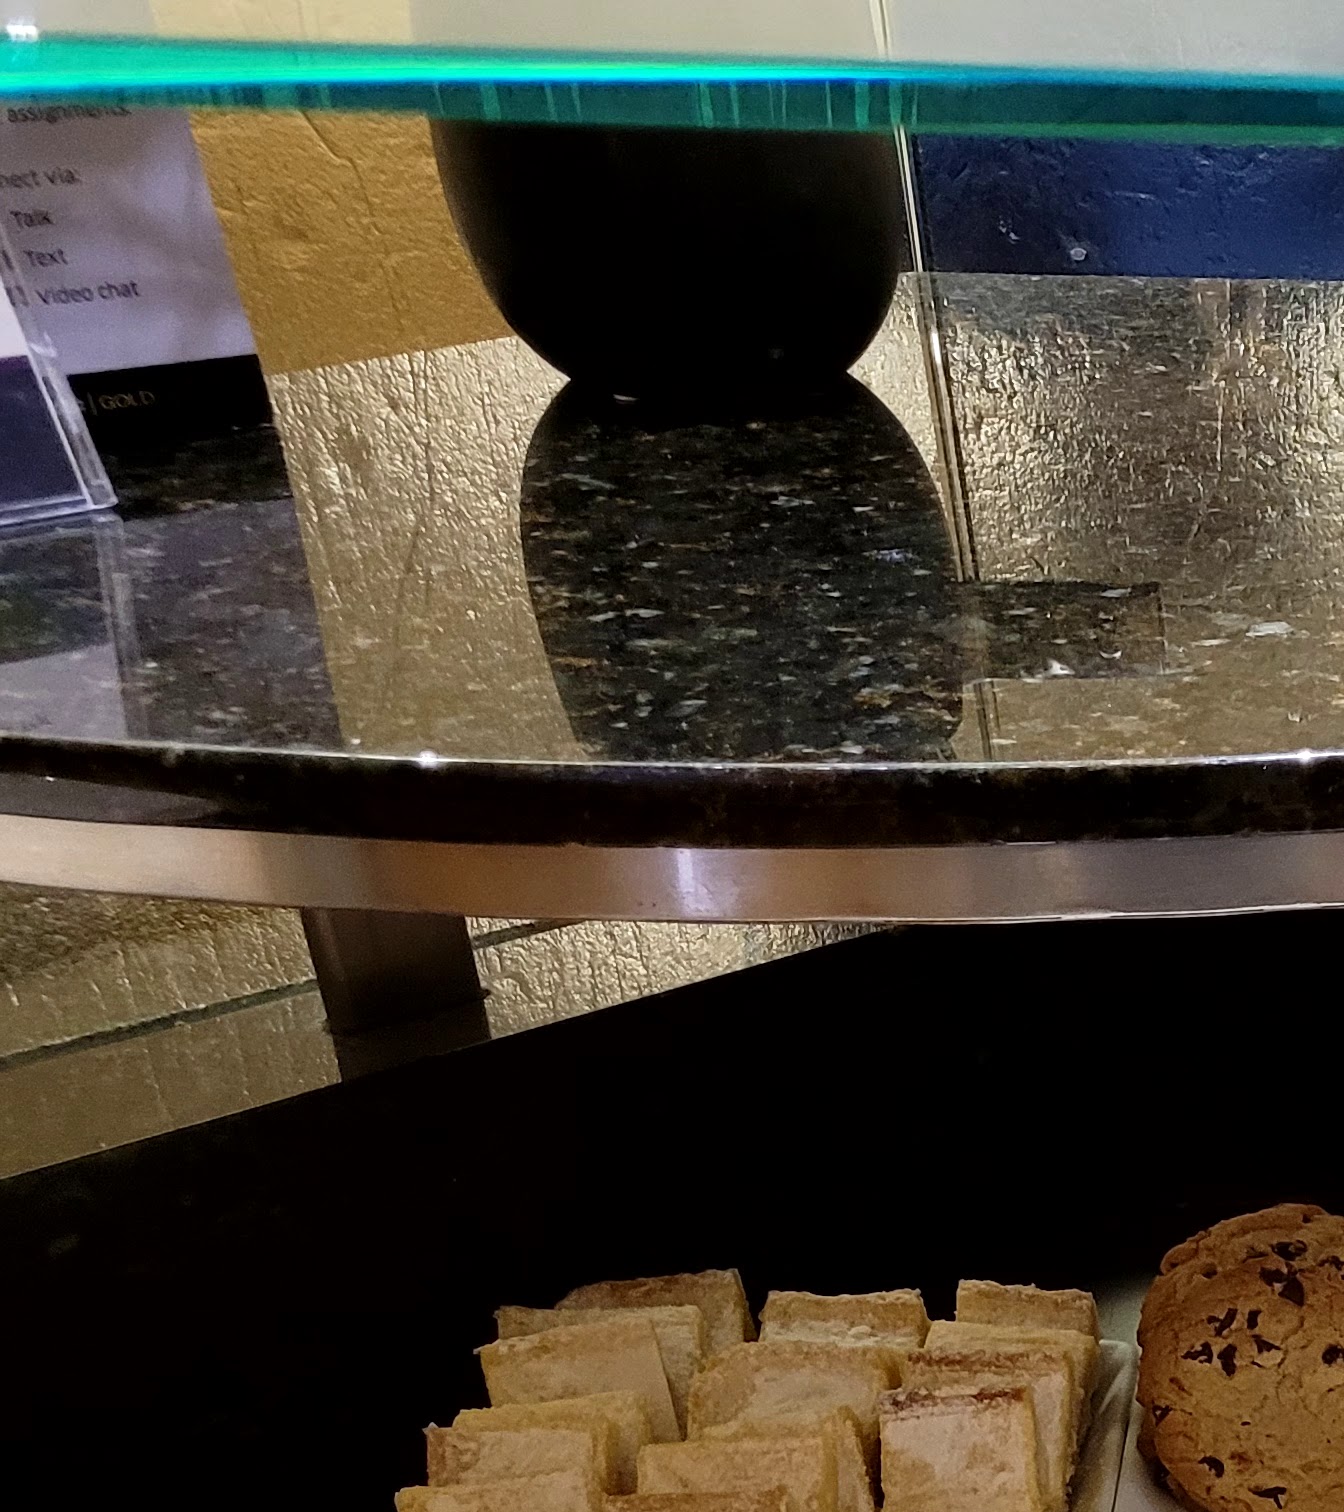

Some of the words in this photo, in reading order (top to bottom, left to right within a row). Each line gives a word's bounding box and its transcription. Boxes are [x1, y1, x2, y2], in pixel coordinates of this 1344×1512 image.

[10, 209, 55, 229] Talk
[23, 248, 68, 268] Text
[98, 280, 140, 299] chat
[98, 390, 156, 410] GOLD
